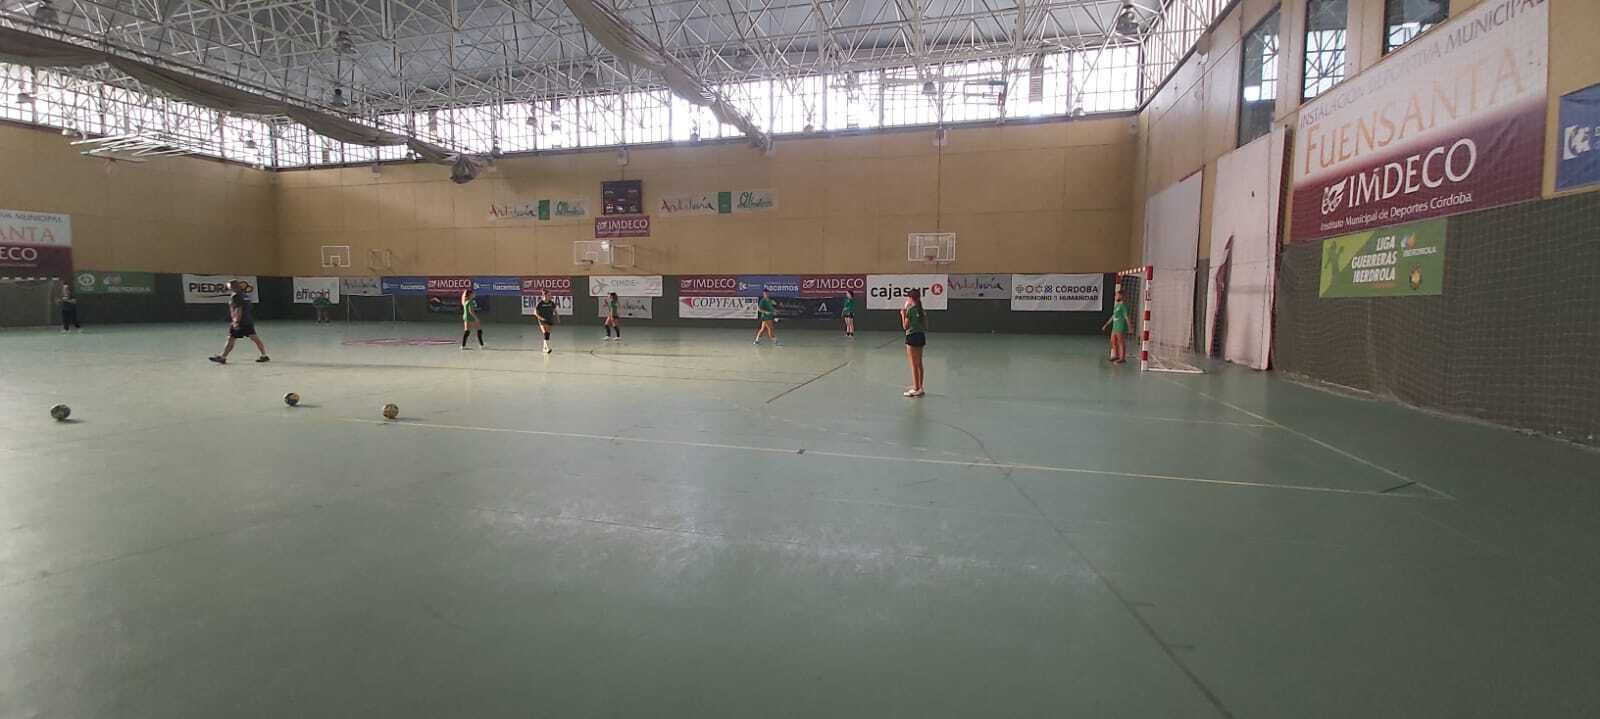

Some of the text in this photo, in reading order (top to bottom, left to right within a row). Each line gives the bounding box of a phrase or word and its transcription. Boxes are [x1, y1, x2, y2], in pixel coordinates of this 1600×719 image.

[1304, 48, 1524, 176] FUENSANTA
[1348, 138, 1477, 208] IMDECO
[1345, 211, 1378, 227] Municipal
[1379, 211, 1389, 219] de
[1390, 201, 1429, 219] Deportes
[1430, 192, 1473, 210] Córdoba
[608, 219, 648, 230] IMDECO
[1376, 236, 1396, 251] LIGA
[1352, 251, 1398, 269] GUERRERAS
[1353, 267, 1396, 283] IBERDROLA
[437, 279, 472, 288] IMDECO
[533, 279, 570, 288] IMDECO
[693, 278, 736, 289] IMDECO
[816, 278, 864, 289] IMDECO
[1055, 284, 1098, 293] CÓRDOBA
[691, 298, 744, 308] COPYFAX
